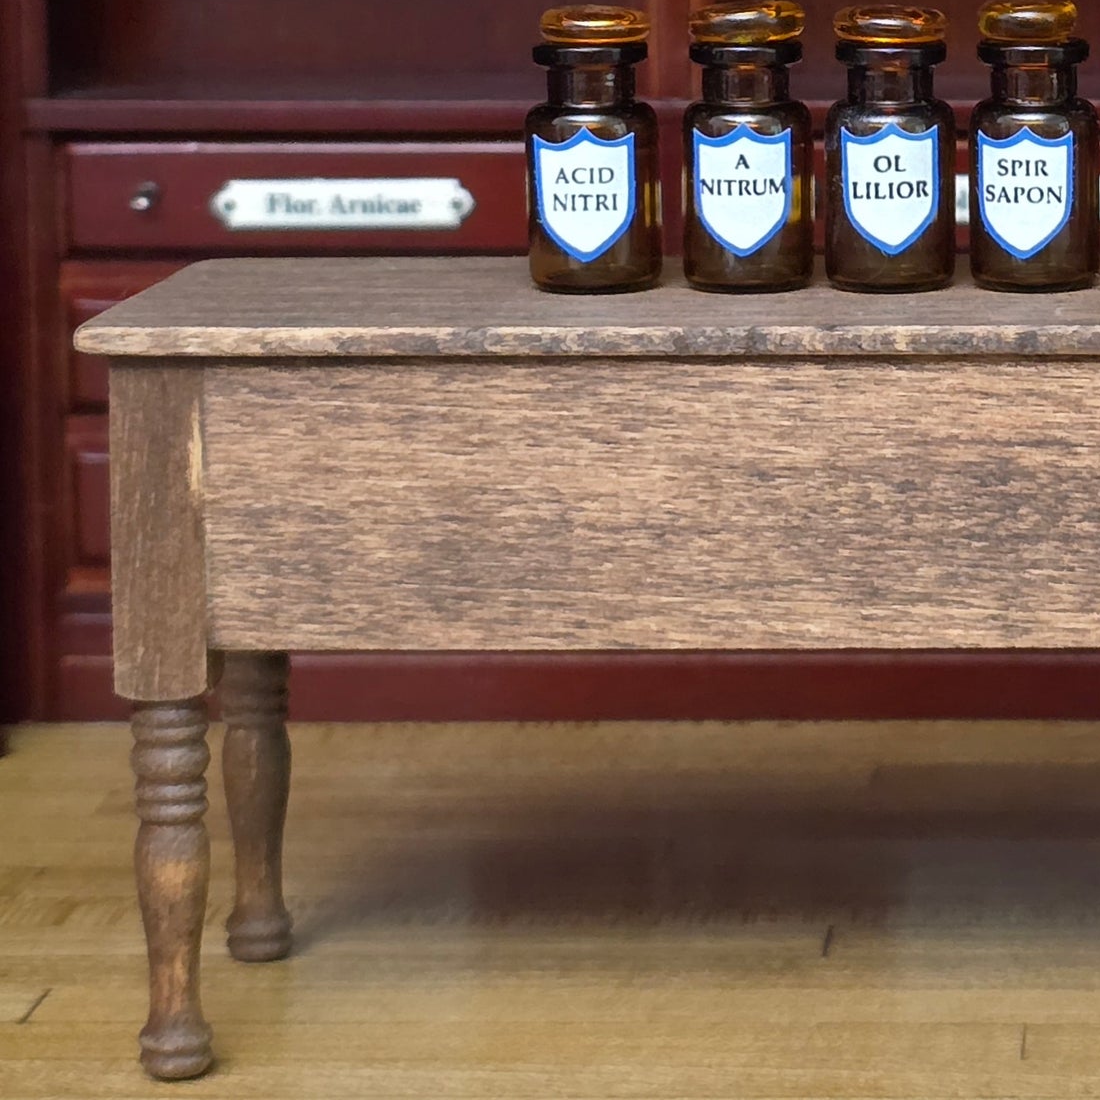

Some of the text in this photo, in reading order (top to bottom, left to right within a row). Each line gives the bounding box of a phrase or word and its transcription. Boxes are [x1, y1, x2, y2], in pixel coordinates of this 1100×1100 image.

[735, 154, 749, 170] A
[873, 155, 907, 172] OL
[996, 159, 1049, 176] SPIR
[555, 167, 614, 184] ACID
[700, 178, 786, 197] NITRUM
[852, 180, 929, 199] LILIOR
[985, 184, 1063, 204] SAPON
[329, 194, 423, 214] Arnicae
[553, 193, 618, 211] NITRI
